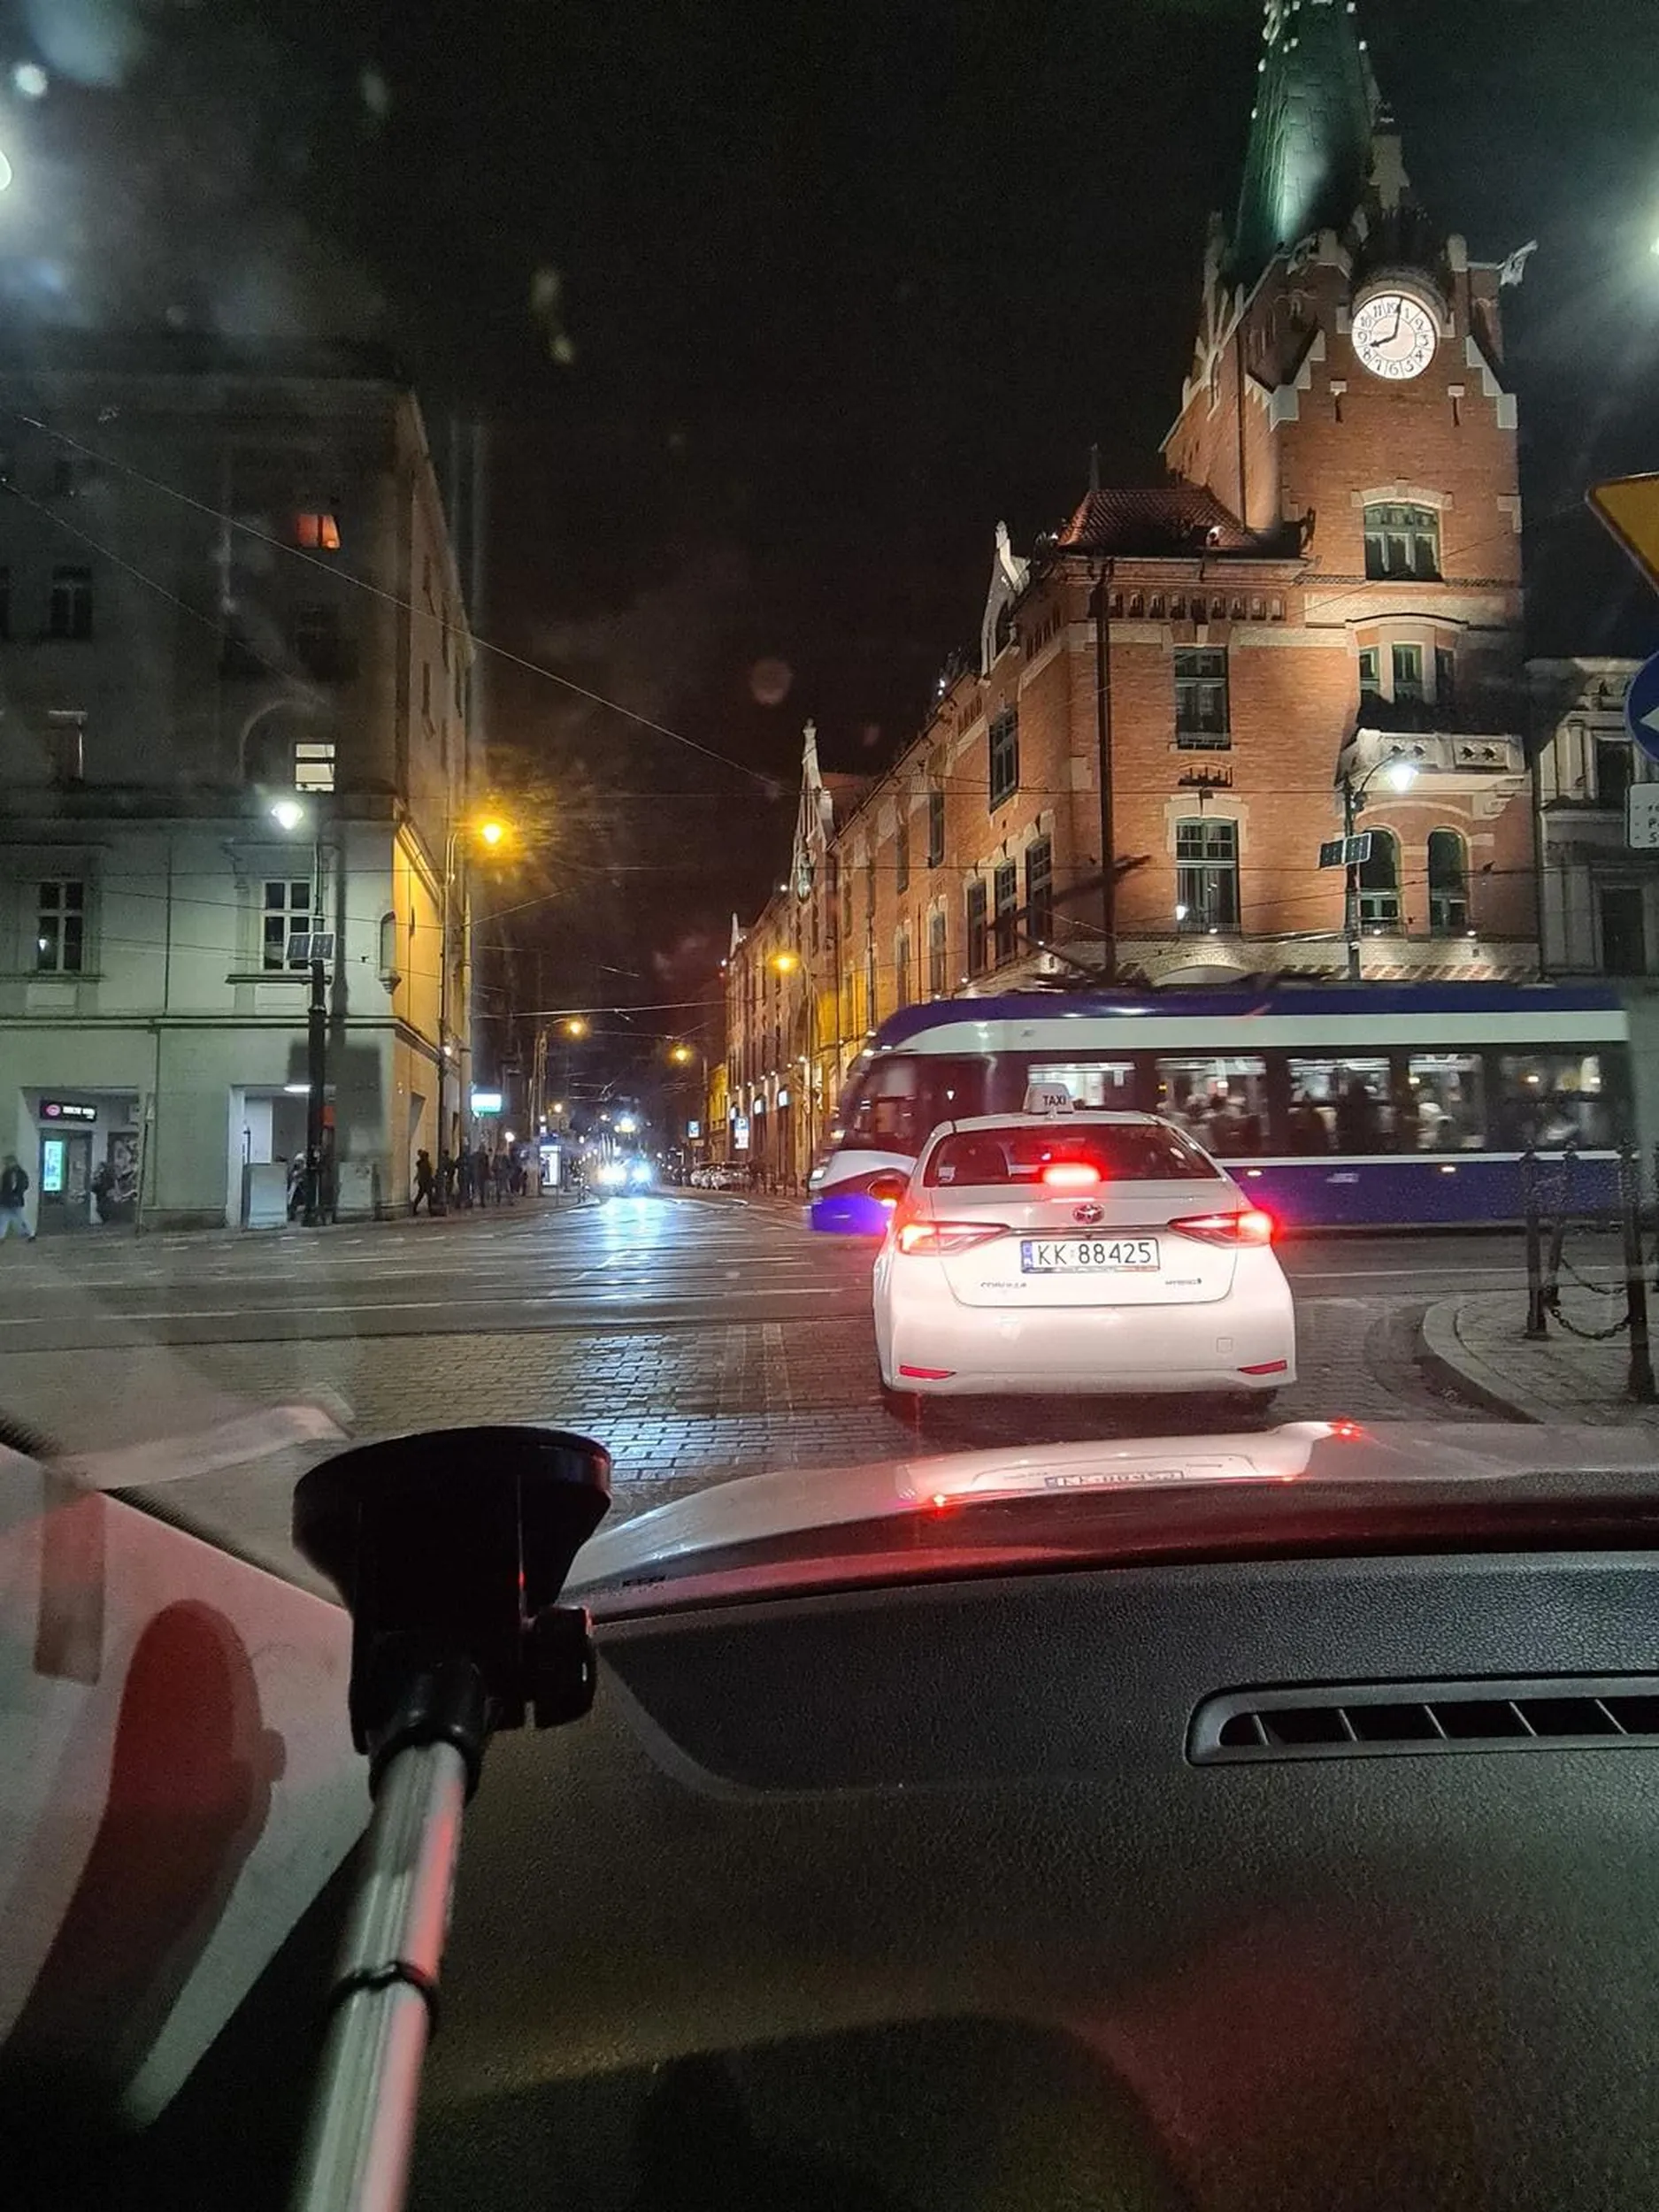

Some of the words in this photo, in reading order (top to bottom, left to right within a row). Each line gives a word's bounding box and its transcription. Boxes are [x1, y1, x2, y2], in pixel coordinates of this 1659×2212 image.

[1373, 304, 1382, 318] 11
[1404, 307, 1409, 319] 1
[1360, 316, 1372, 327] 10
[1415, 318, 1424, 330] 2
[1357, 331, 1368, 344] 9
[1420, 334, 1429, 346] 3
[1363, 347, 1371, 361] 8
[1415, 349, 1424, 362] 4
[1375, 358, 1382, 371] 7
[1388, 363, 1399, 376] 6
[1404, 360, 1415, 373] 5
[1042, 1094, 1067, 1106] TAXI
[1038, 1244, 1067, 1265] KK
[1078, 1241, 1152, 1264] 88425
